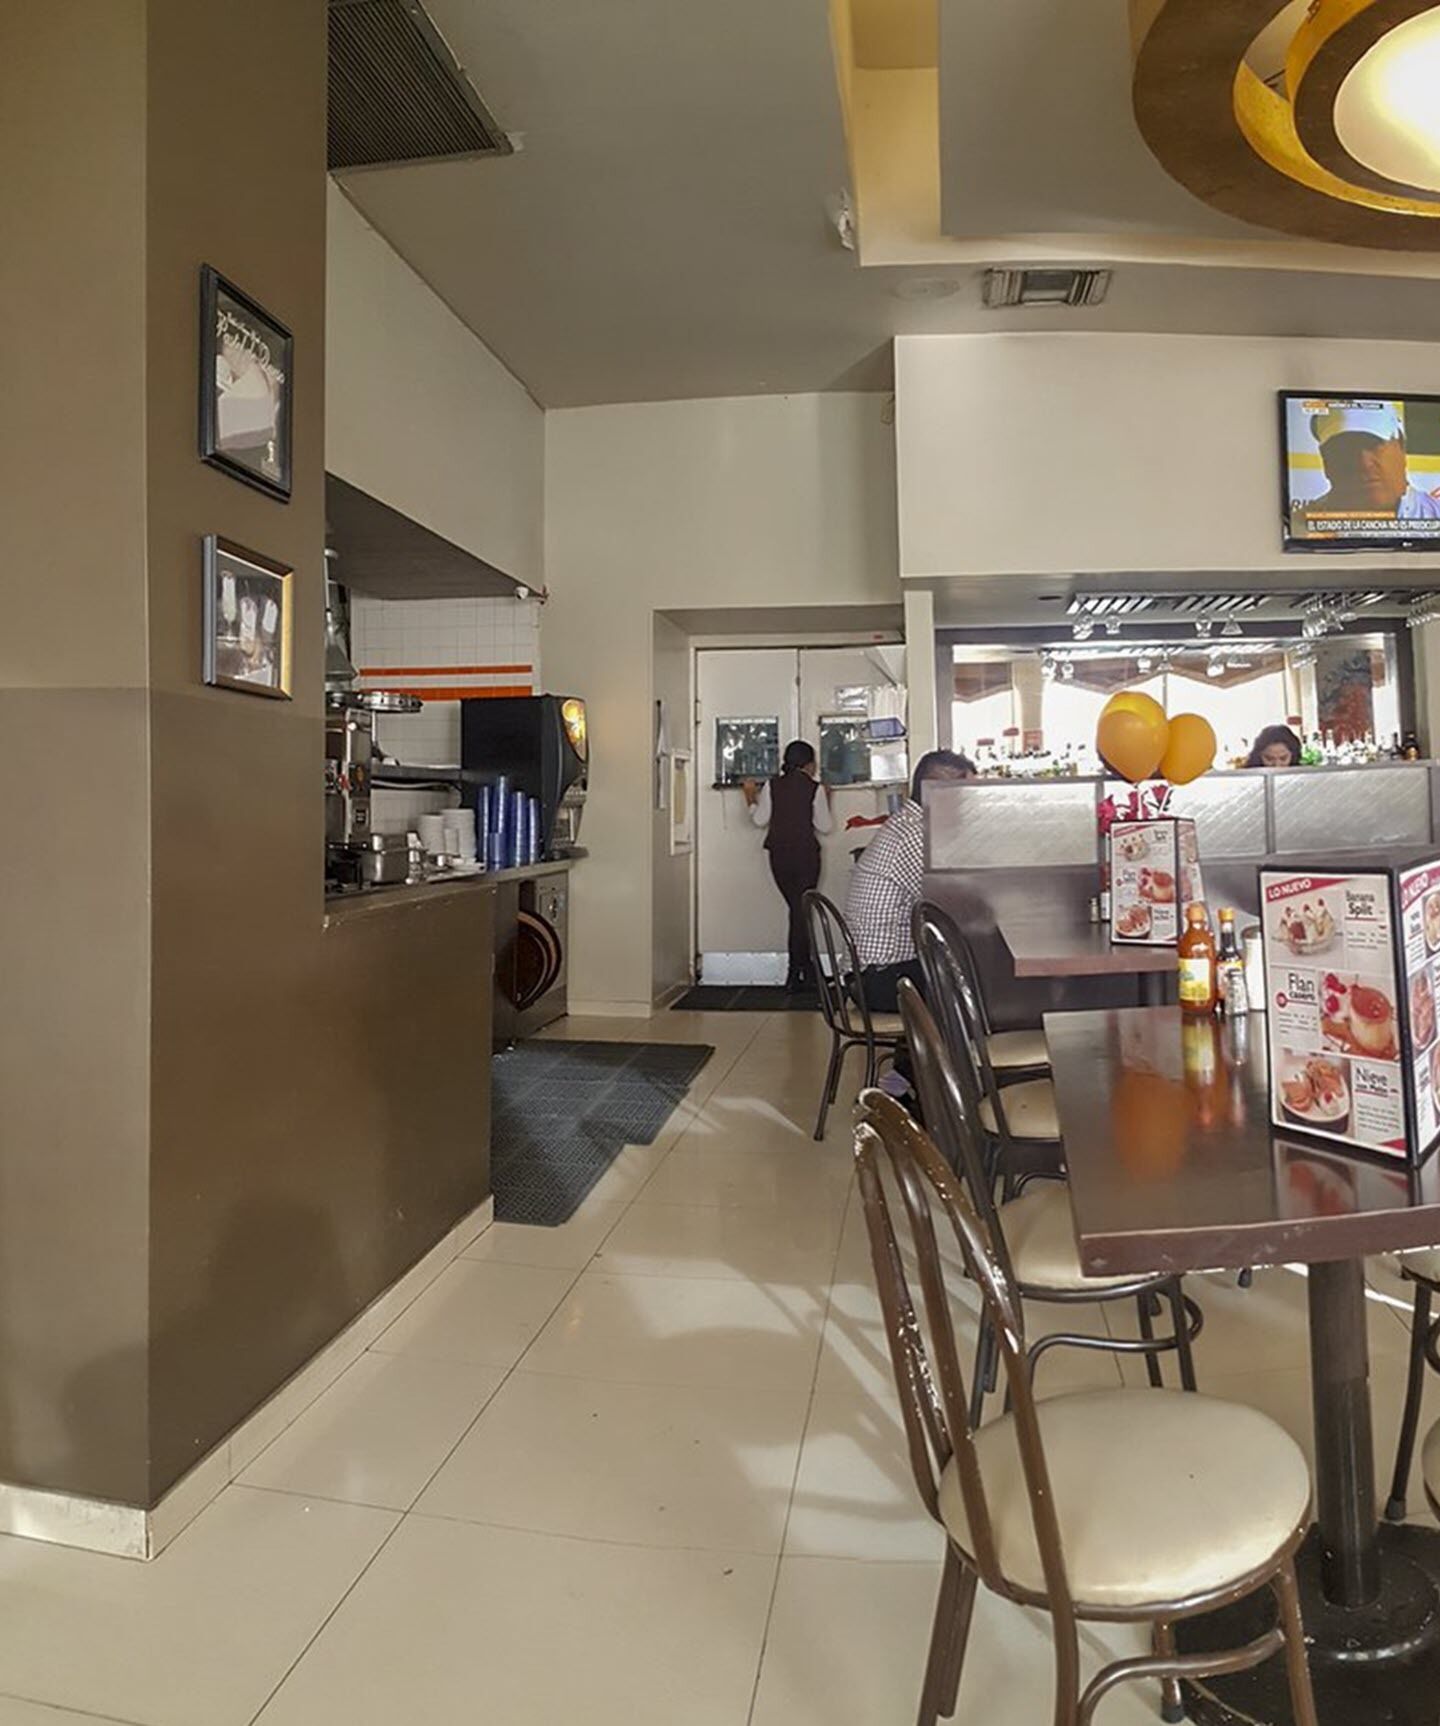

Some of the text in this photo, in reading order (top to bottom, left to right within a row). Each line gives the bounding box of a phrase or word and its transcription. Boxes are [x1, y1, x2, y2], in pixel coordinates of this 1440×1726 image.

[1317, 520, 1342, 531] ESTADO
[1361, 520, 1388, 531] CANCHA
[1389, 520, 1399, 531] NO
[1268, 878, 1312, 899] LO NUEVO
[1348, 902, 1373, 918] Split
[1288, 972, 1315, 992] Flan
[1356, 1067, 1388, 1087] Nieve
